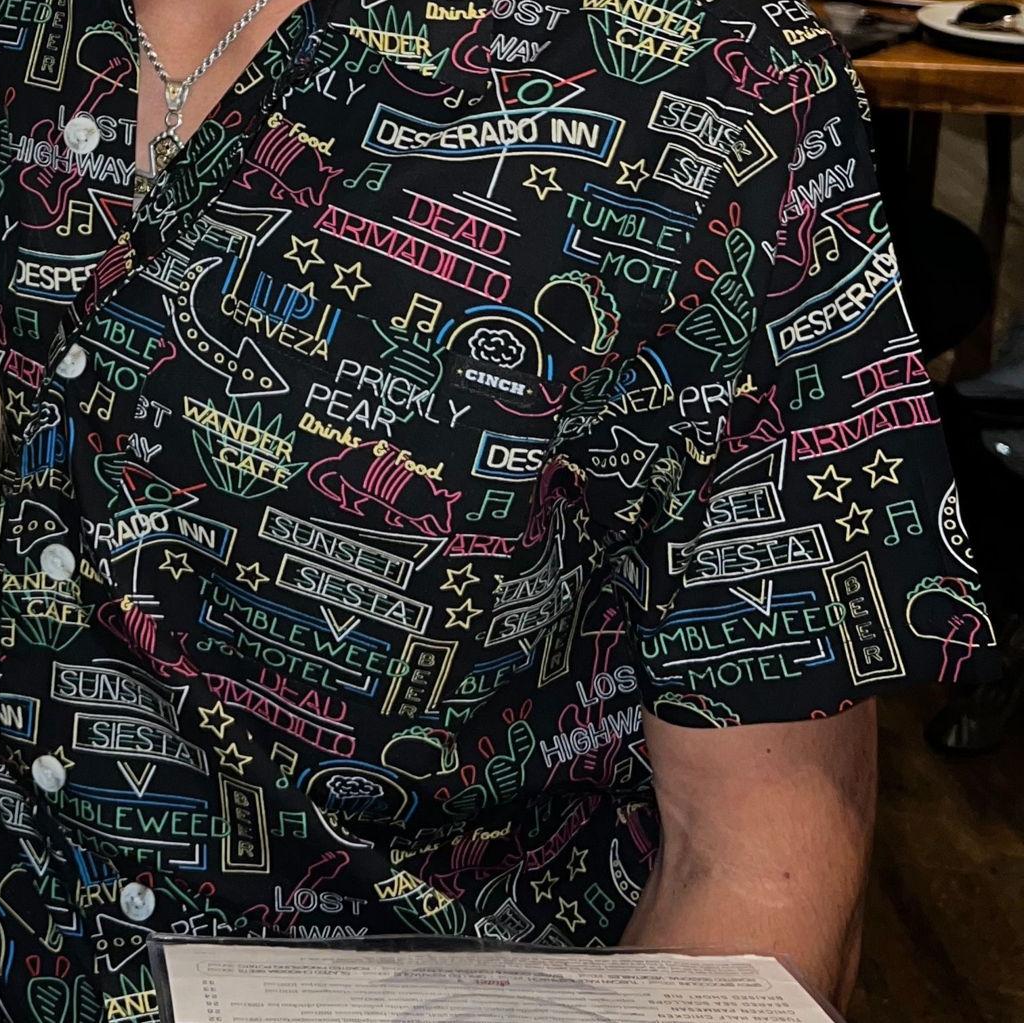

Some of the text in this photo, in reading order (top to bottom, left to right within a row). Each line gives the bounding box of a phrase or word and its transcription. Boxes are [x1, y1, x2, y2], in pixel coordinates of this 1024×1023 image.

[425, 2, 487, 22] Drinks
[614, 27, 691, 64] CAFE
[59, 105, 138, 145] LST
[288, 122, 336, 156] Food
[376, 118, 600, 150] DESPERADO INN
[8, 132, 137, 185] HIGHWAY
[407, 193, 506, 256] DEAD
[313, 205, 512, 304] ARMADILLO
[221, 293, 329, 361] CERVEZA
[305, 382, 397, 438] PEAR
[334, 359, 472, 427] PRICKLY
[464, 367, 526, 397] CINCH
[182, 395, 293, 463] WANDER
[298, 412, 445, 481] Drinks & Food
[218, 448, 293, 486] CAFE
[177, 516, 216, 549] INN
[271, 515, 401, 577] SUNSET
[697, 536, 813, 577] SIESTA
[297, 566, 408, 625] SIESTA
[845, 577, 883, 665] BEER
[198, 576, 411, 677] TUMBLEWEED
[641, 601, 848, 660] UMBLEWEED
[237, 632, 338, 691] MOTEL
[397, 651, 436, 720] BEER
[688, 653, 803, 692] MOTEL
[91, 721, 193, 761] SIESTA
[233, 790, 255, 859] BEER
[472, 820, 513, 843] Food
[274, 885, 368, 916] LOST
